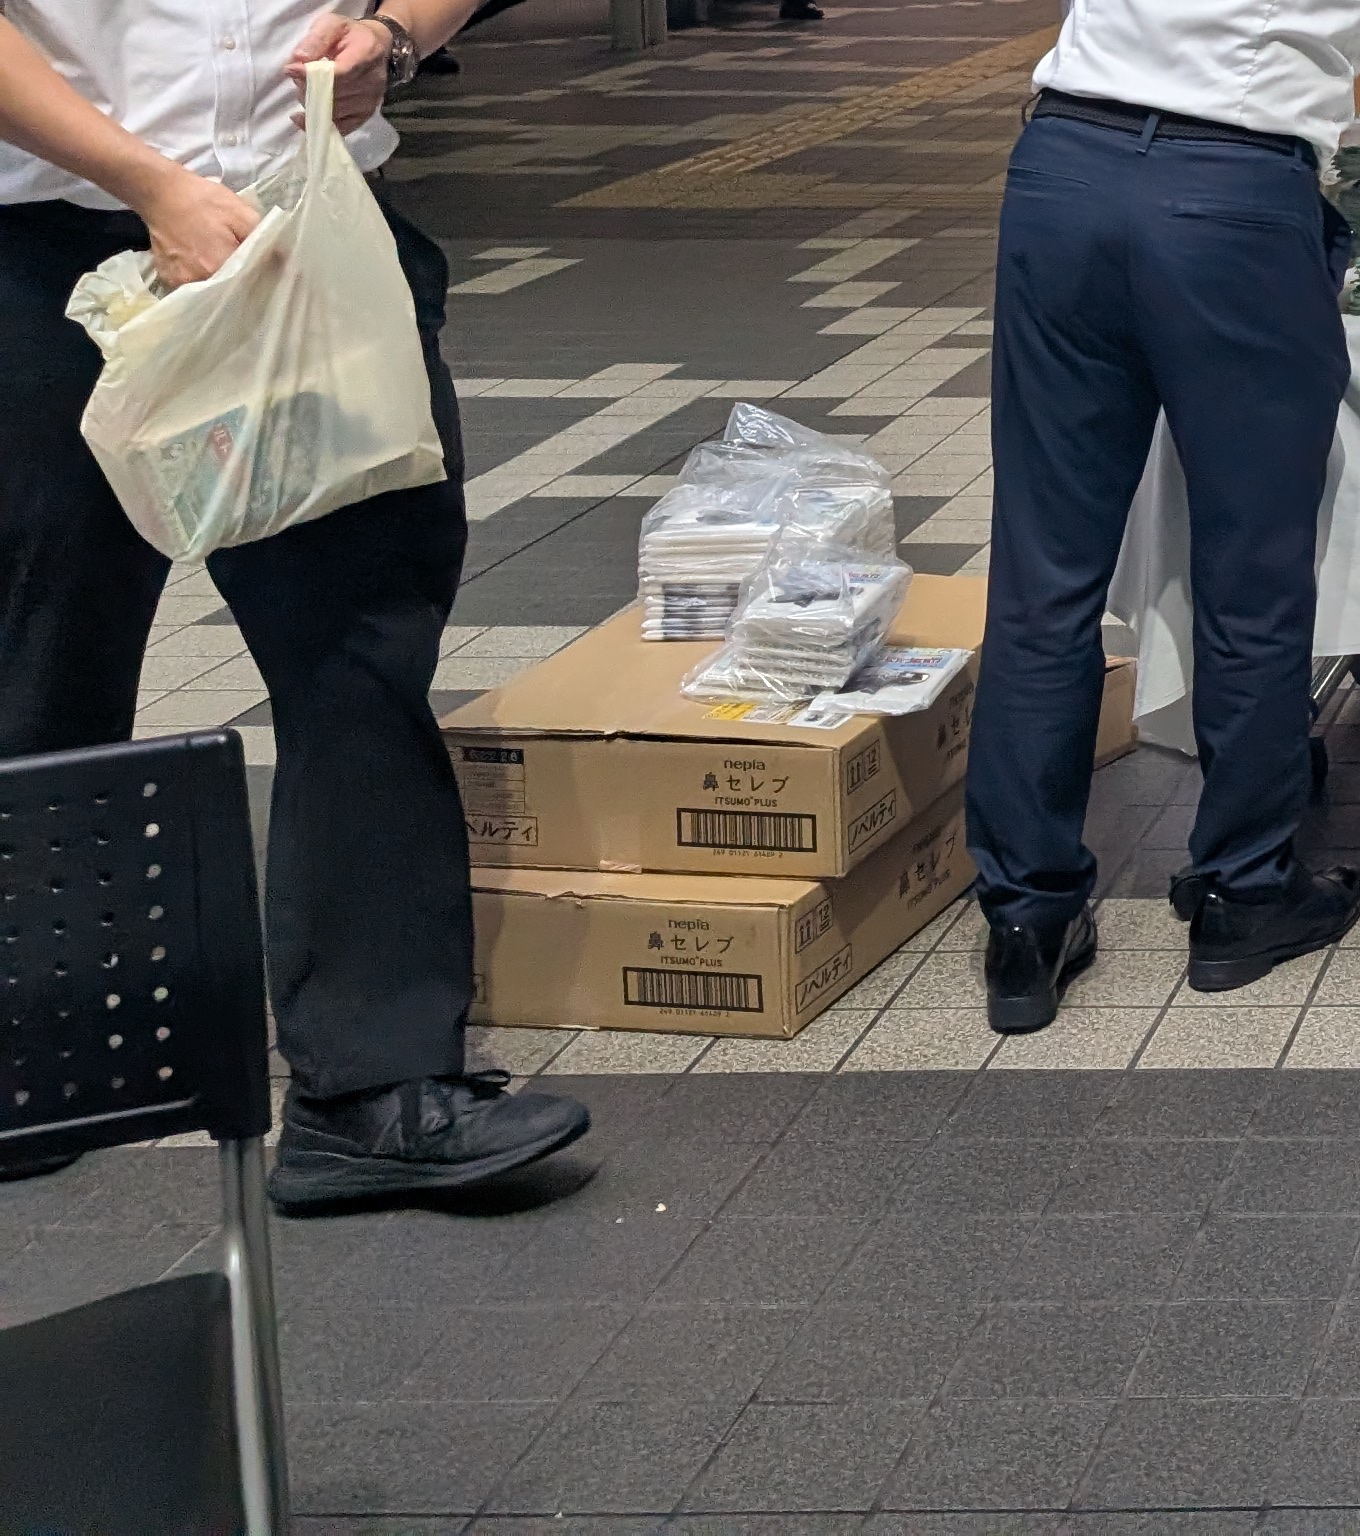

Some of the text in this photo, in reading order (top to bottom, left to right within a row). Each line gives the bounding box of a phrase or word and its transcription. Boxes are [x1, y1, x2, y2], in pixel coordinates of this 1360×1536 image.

[850, 798, 896, 846] ノベルティ
[799, 957, 850, 1007] ノベルティ
